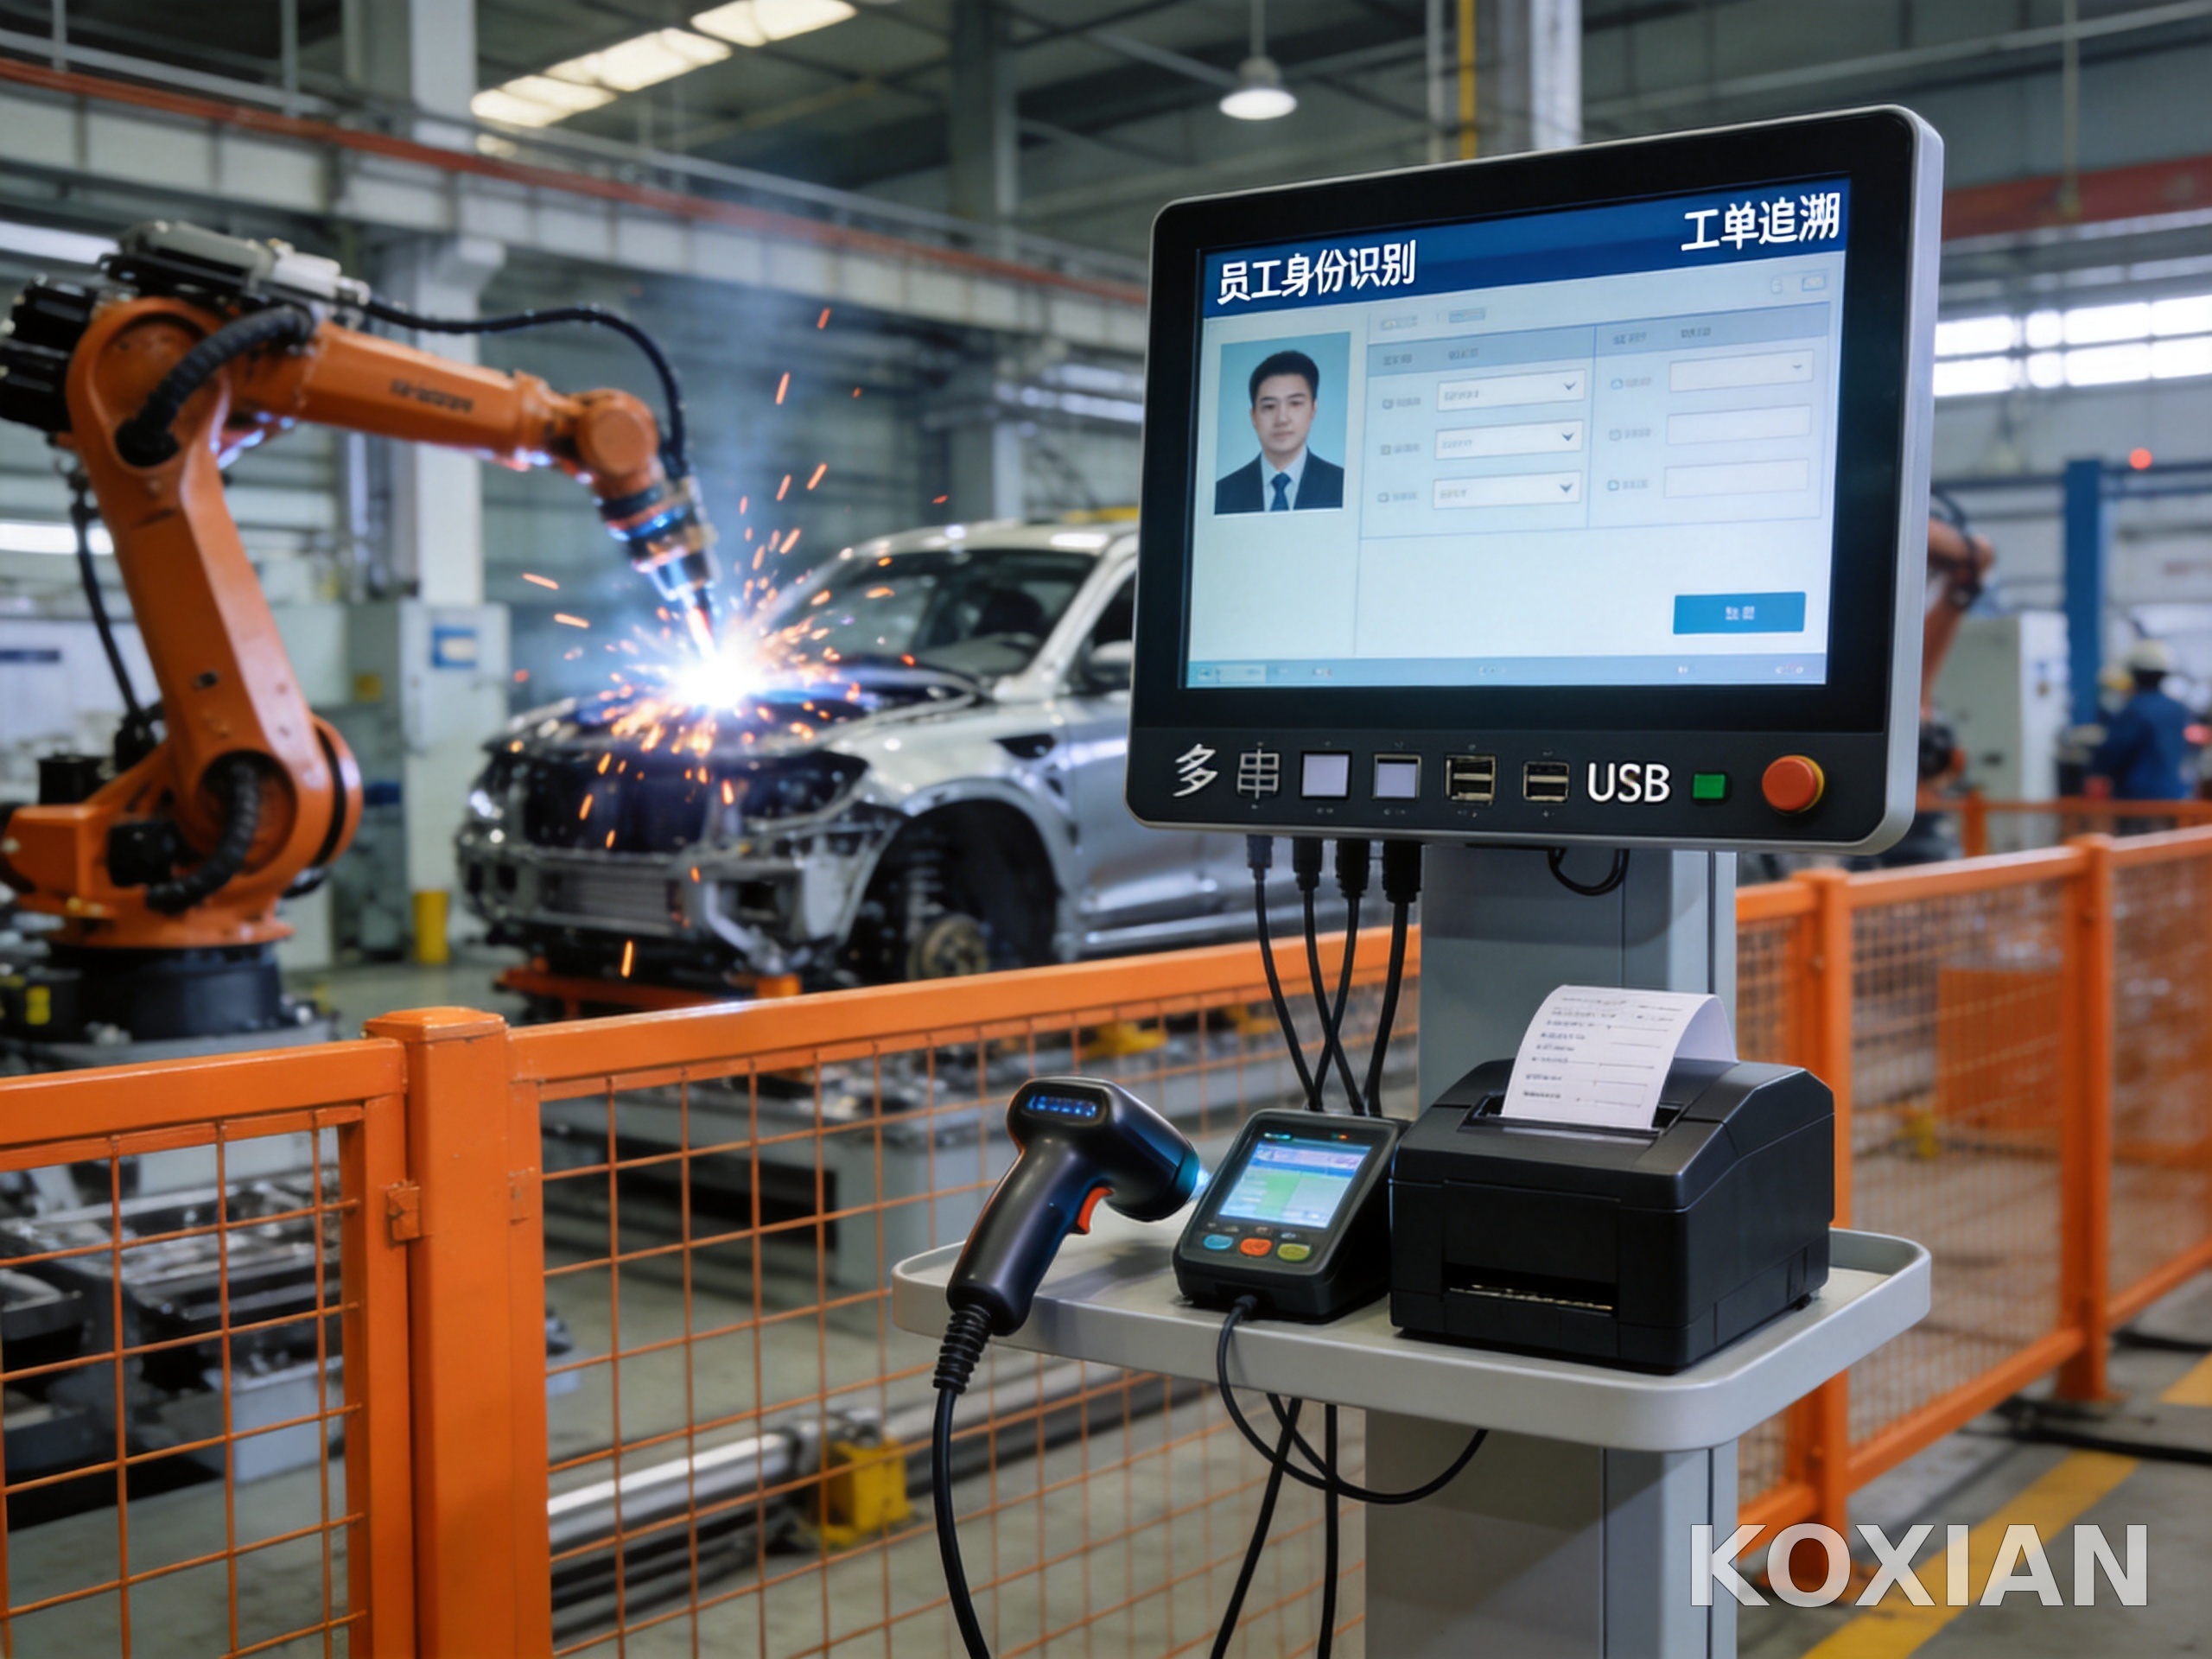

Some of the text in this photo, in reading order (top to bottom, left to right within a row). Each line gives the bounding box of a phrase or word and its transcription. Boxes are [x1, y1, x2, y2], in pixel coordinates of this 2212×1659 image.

[1681, 192, 1841, 251] 工单追溯
[1217, 238, 1417, 305] 员工身份识别
[1587, 762, 1671, 803] USB
